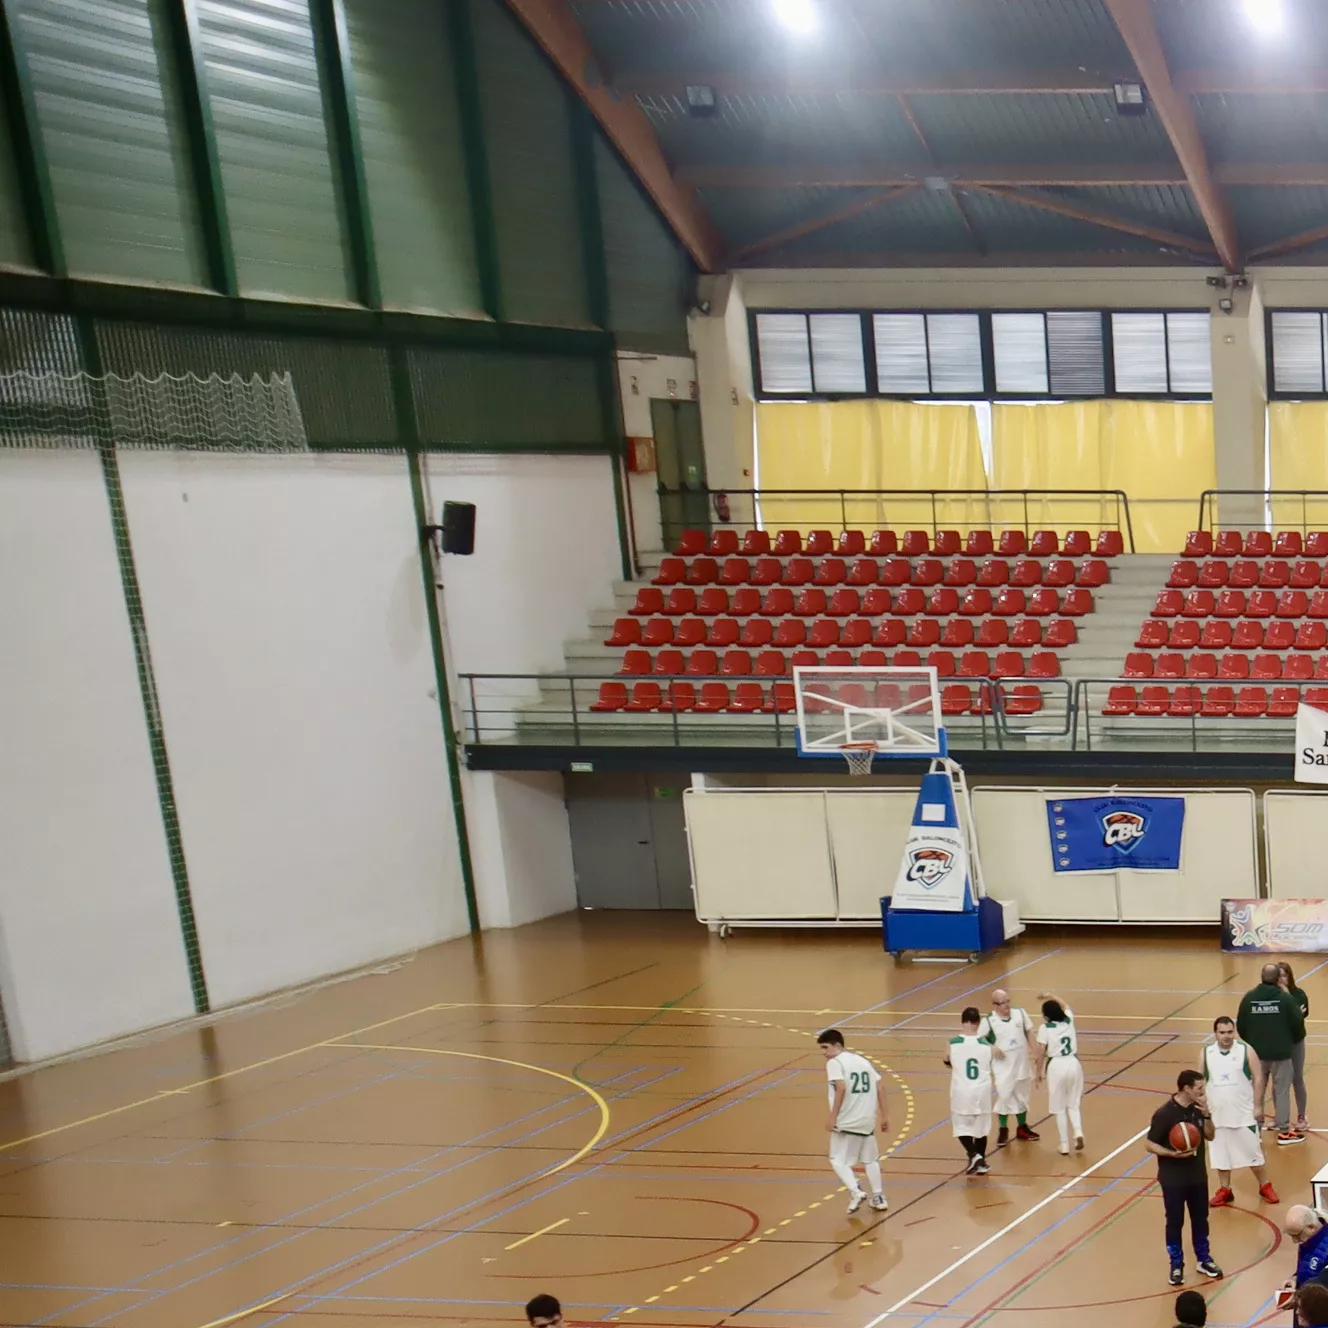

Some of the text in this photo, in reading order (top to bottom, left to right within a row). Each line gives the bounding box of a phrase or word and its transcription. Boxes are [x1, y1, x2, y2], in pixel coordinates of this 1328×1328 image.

[1104, 822, 1145, 846] CBL
[907, 858, 952, 882] CBL
[1060, 1036, 1072, 1056] 3
[966, 1057, 979, 1080] 6
[850, 1071, 871, 1094] 29
